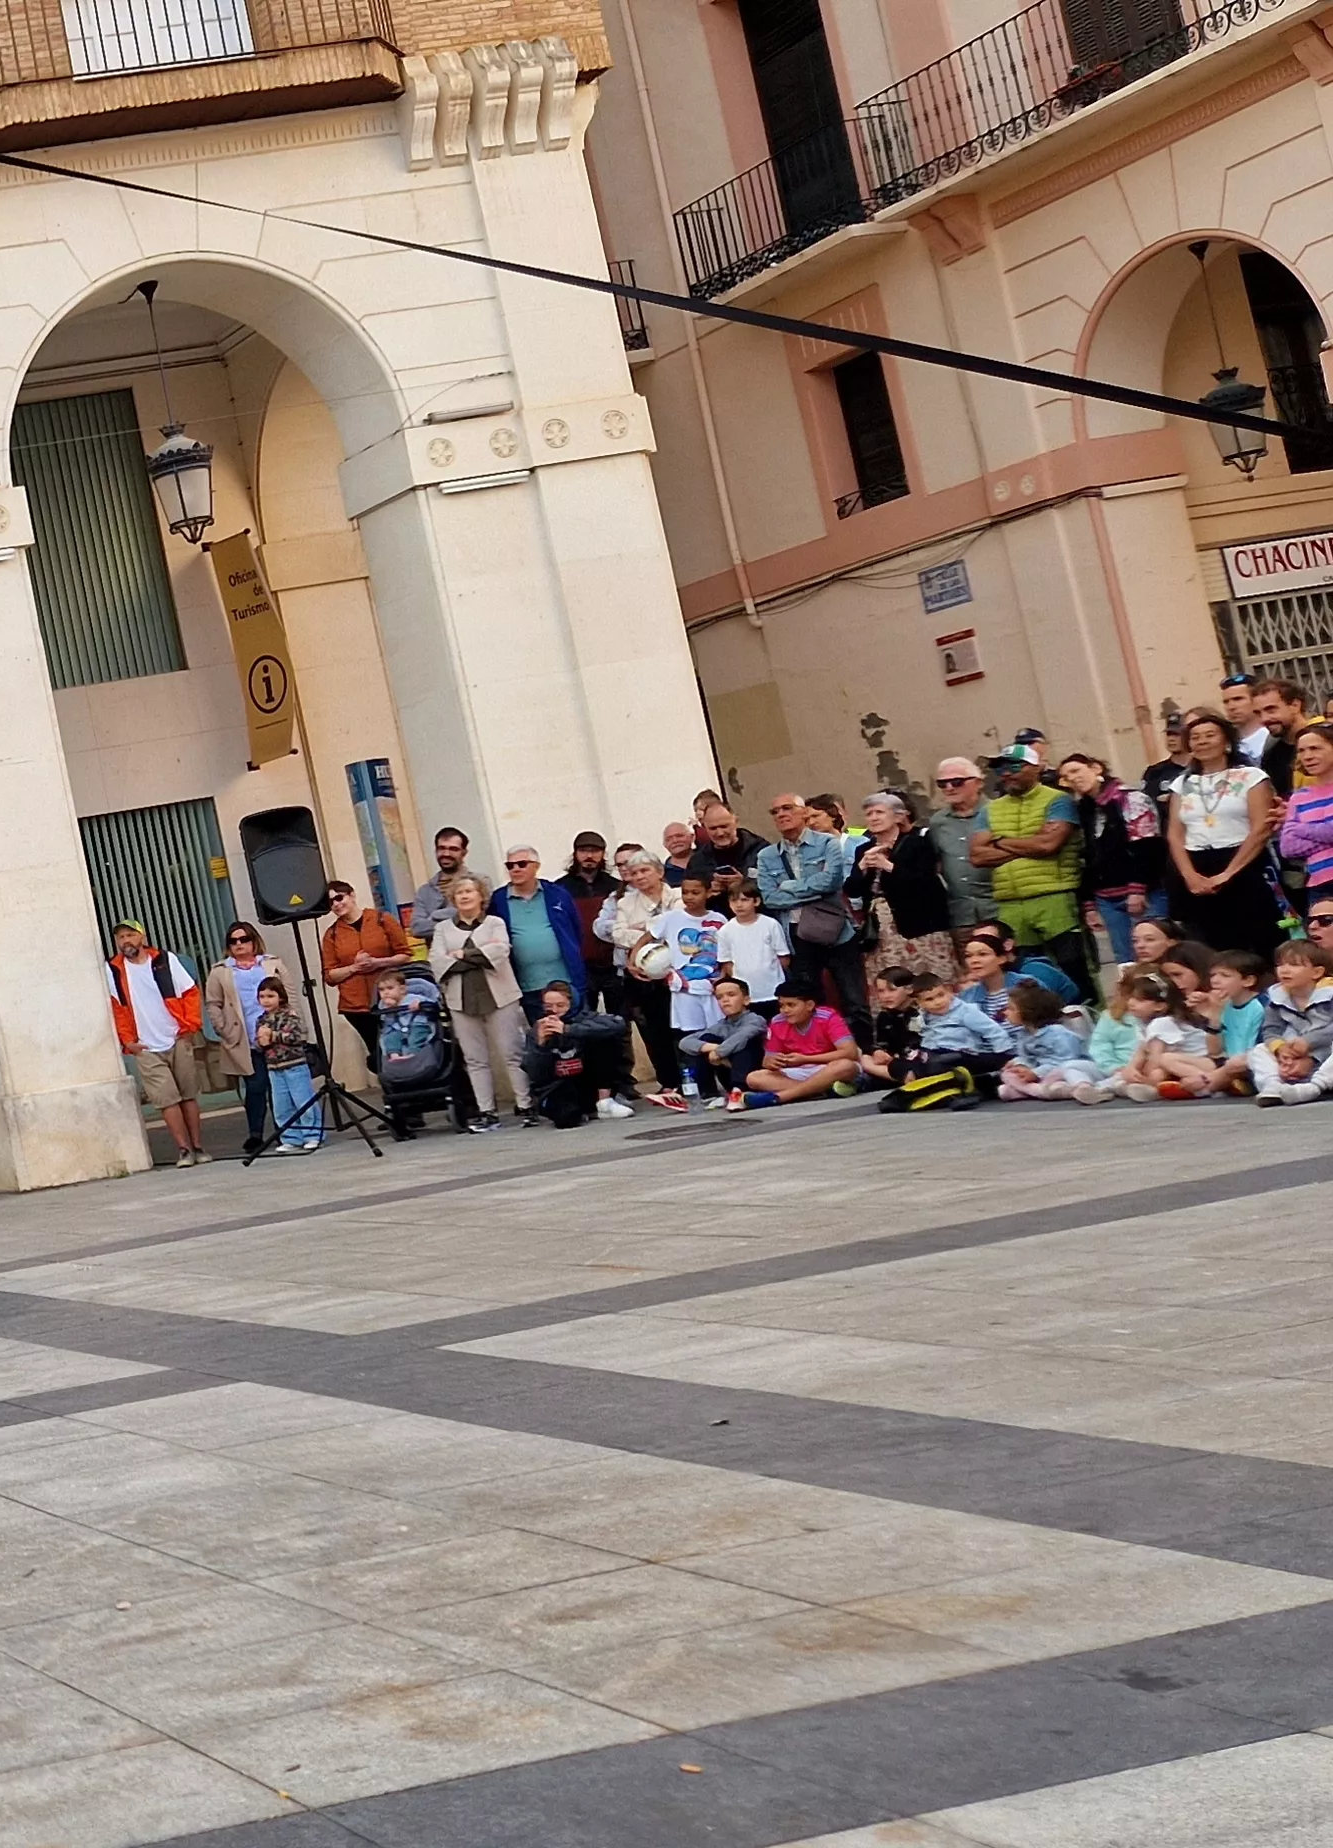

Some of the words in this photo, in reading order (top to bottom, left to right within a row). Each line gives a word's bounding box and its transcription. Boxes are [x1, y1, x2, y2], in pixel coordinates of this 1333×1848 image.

[1235, 538, 1333, 578] CHACIN
[253, 583, 264, 597] de
[231, 602, 270, 621] Turismo
